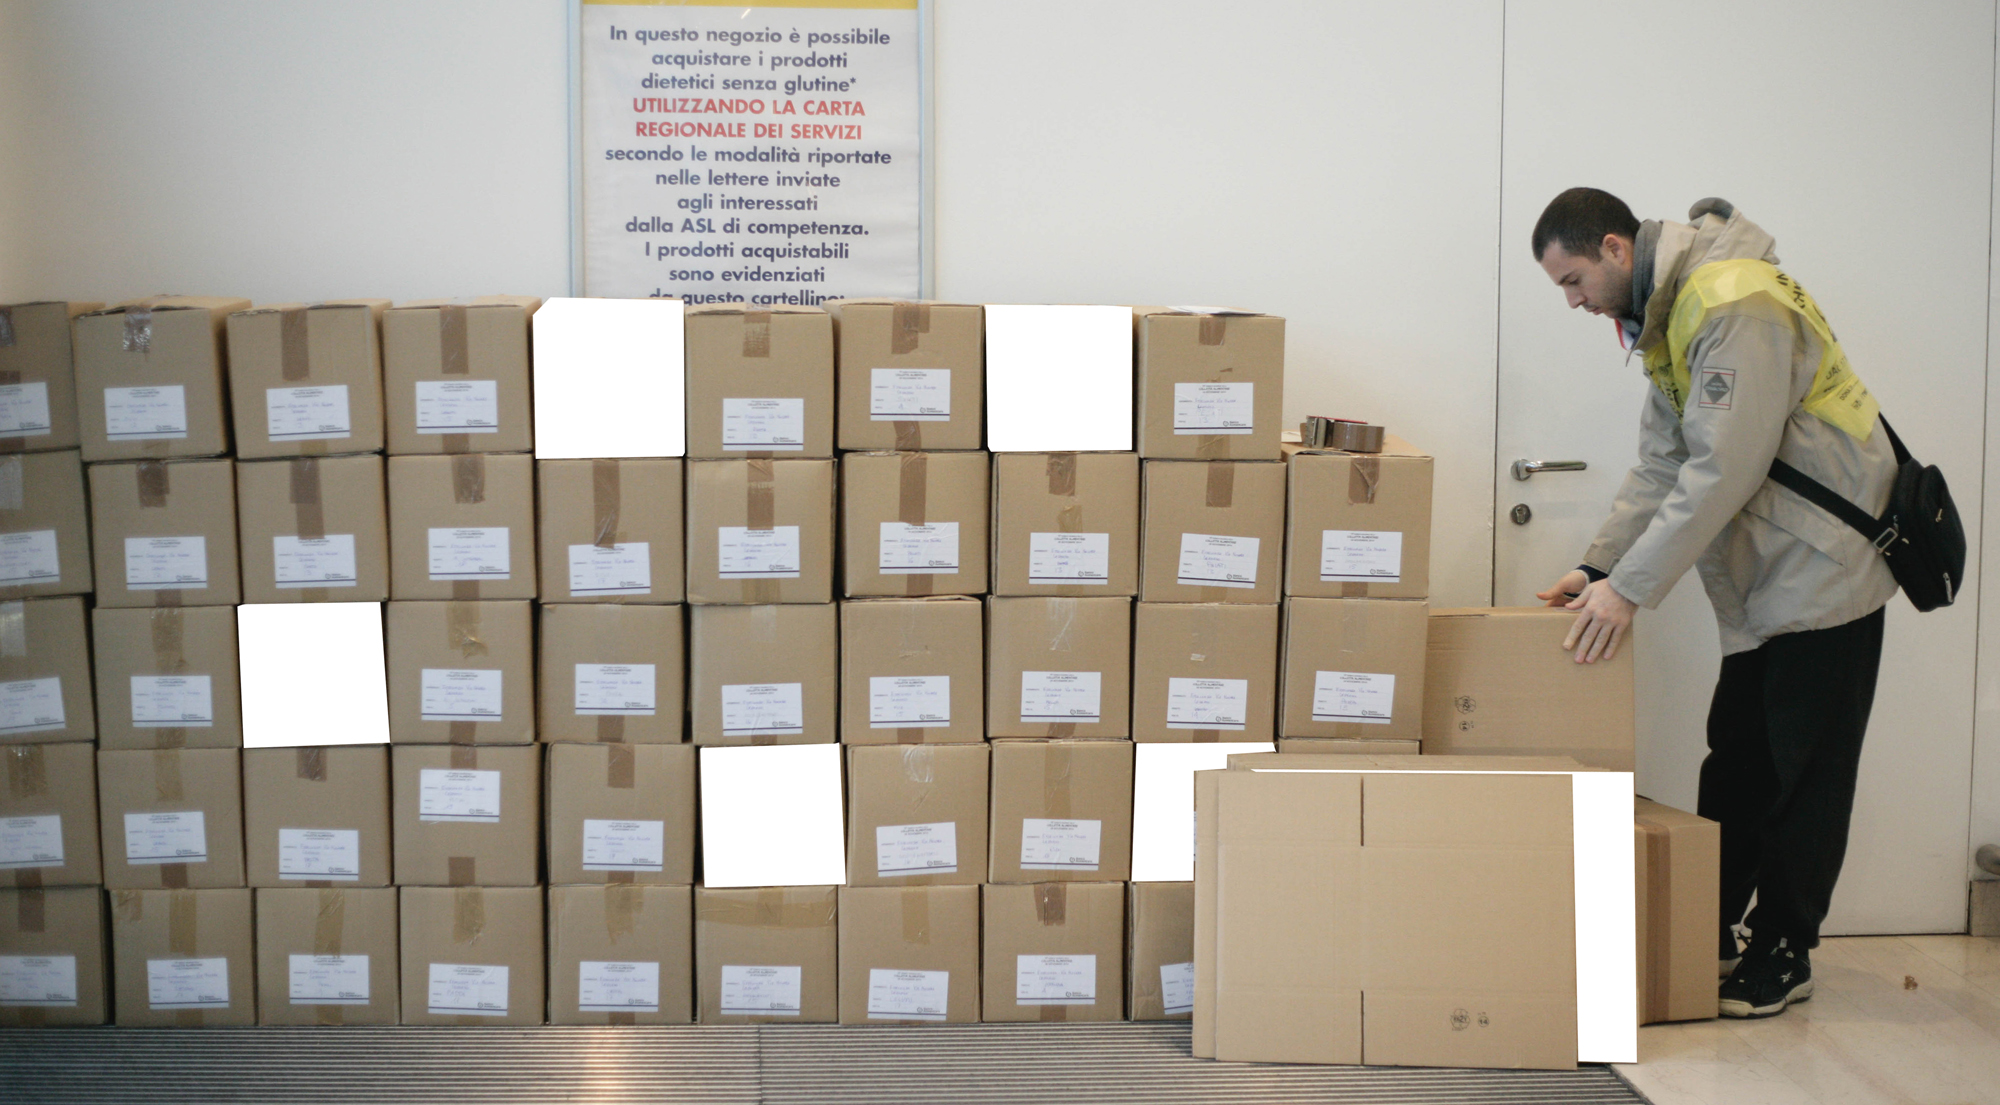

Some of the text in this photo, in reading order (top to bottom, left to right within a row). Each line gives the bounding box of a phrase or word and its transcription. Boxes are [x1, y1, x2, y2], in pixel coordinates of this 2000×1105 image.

[610, 26, 890, 48] In questo negozio è possibile
[651, 50, 847, 71] acquistare i prodotti
[640, 73, 714, 89] dietetici
[721, 78, 776, 90] senza
[632, 98, 865, 116] UTILIZZANDO LA CARTA
[635, 122, 861, 139] REGIONALE DEI SERVIZI
[605, 145, 891, 167] secondo le modalità riportate
[655, 169, 840, 187] nelle lettere inviate
[676, 193, 817, 213] agli interessati
[625, 216, 869, 238] dalla ASL di competenza.
[645, 241, 848, 262] I prodotti acquistabili
[668, 265, 824, 282] sono evidenziati
